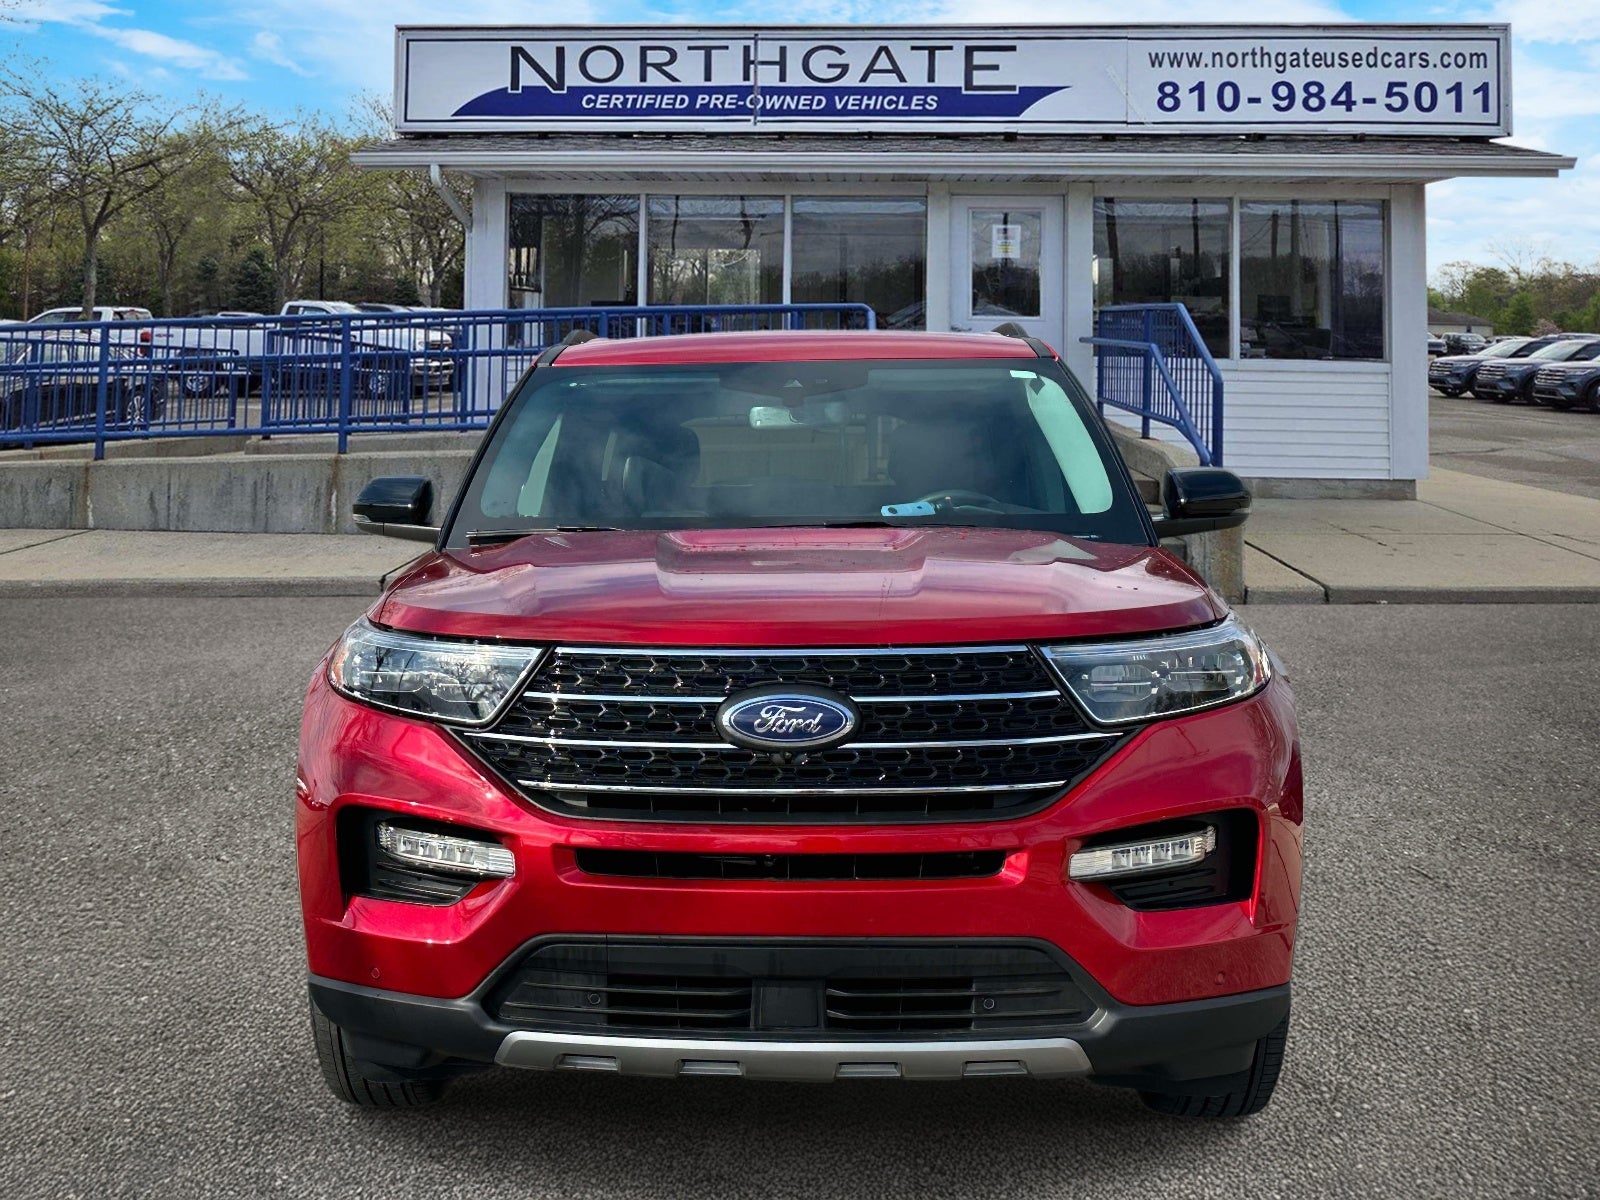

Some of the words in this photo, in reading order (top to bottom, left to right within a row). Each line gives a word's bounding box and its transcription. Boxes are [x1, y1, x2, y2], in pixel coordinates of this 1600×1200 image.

[508, 44, 1018, 93] NORTHGATE
[1148, 46, 1488, 73] www.northgateusedcars.com
[581, 93, 690, 110] CERTIFIED
[695, 94, 827, 111] PRE-OWNED
[833, 94, 939, 111] VEHICLES
[1156, 80, 1491, 113] 810-984-5011
[753, 704, 824, 734] Ford
